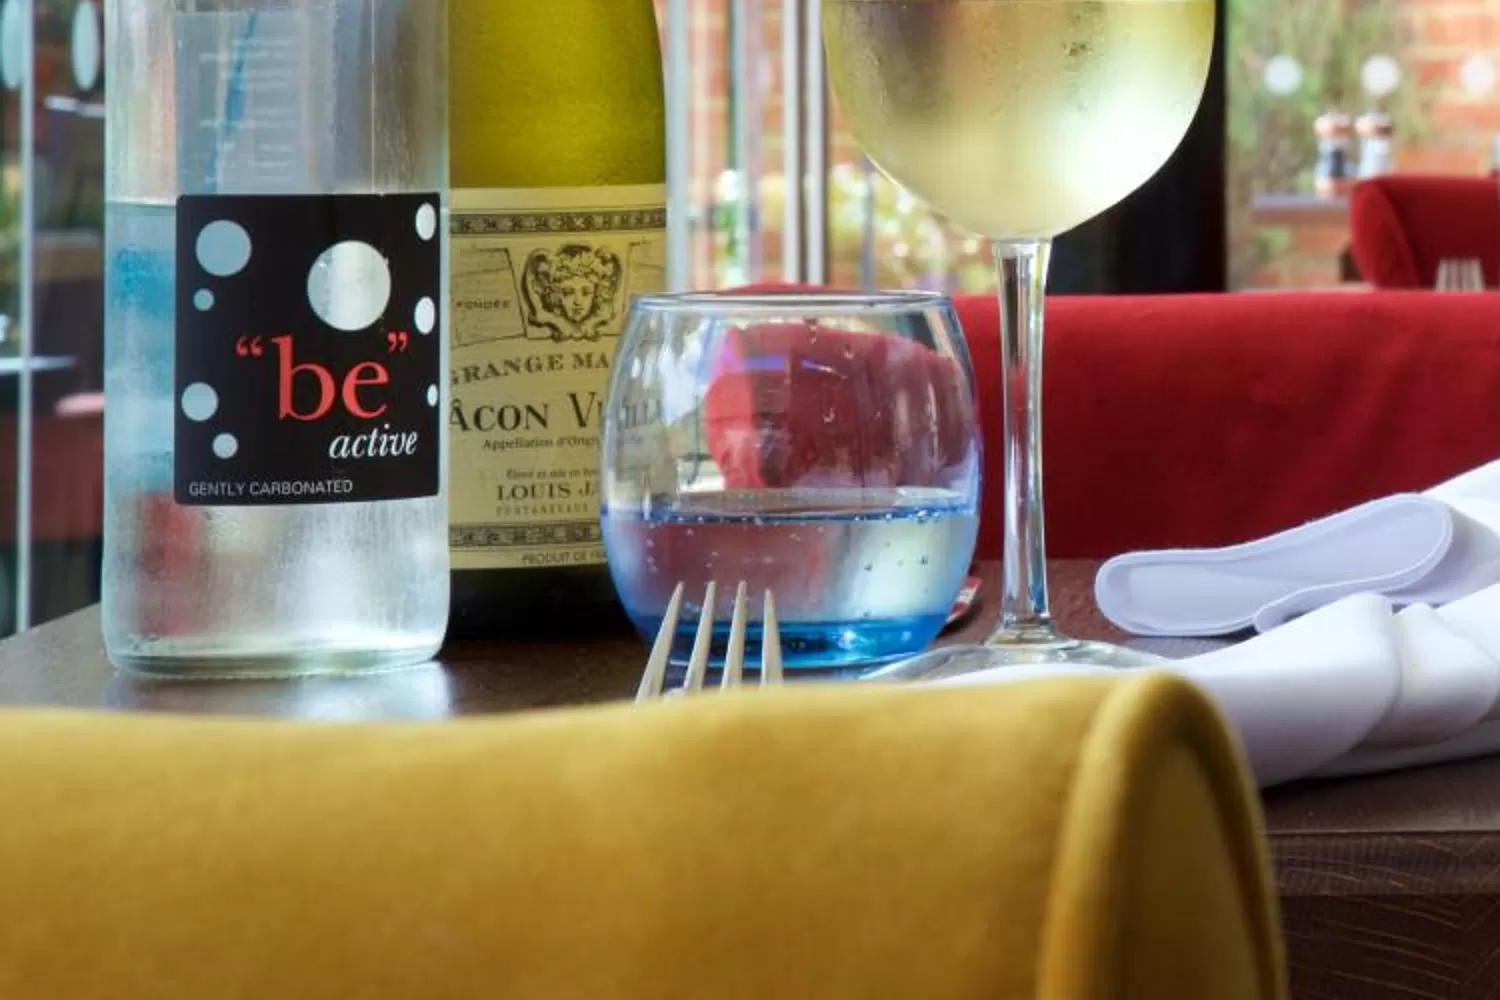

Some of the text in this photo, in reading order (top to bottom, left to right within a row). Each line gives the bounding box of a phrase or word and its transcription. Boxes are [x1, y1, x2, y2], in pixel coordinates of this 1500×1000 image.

[571, 351, 609, 371] MA
[449, 397, 550, 432] ÂCON
[328, 423, 419, 459] active
[188, 478, 354, 497] GENTLY CARBONATED
[496, 481, 572, 501] LOUIS
